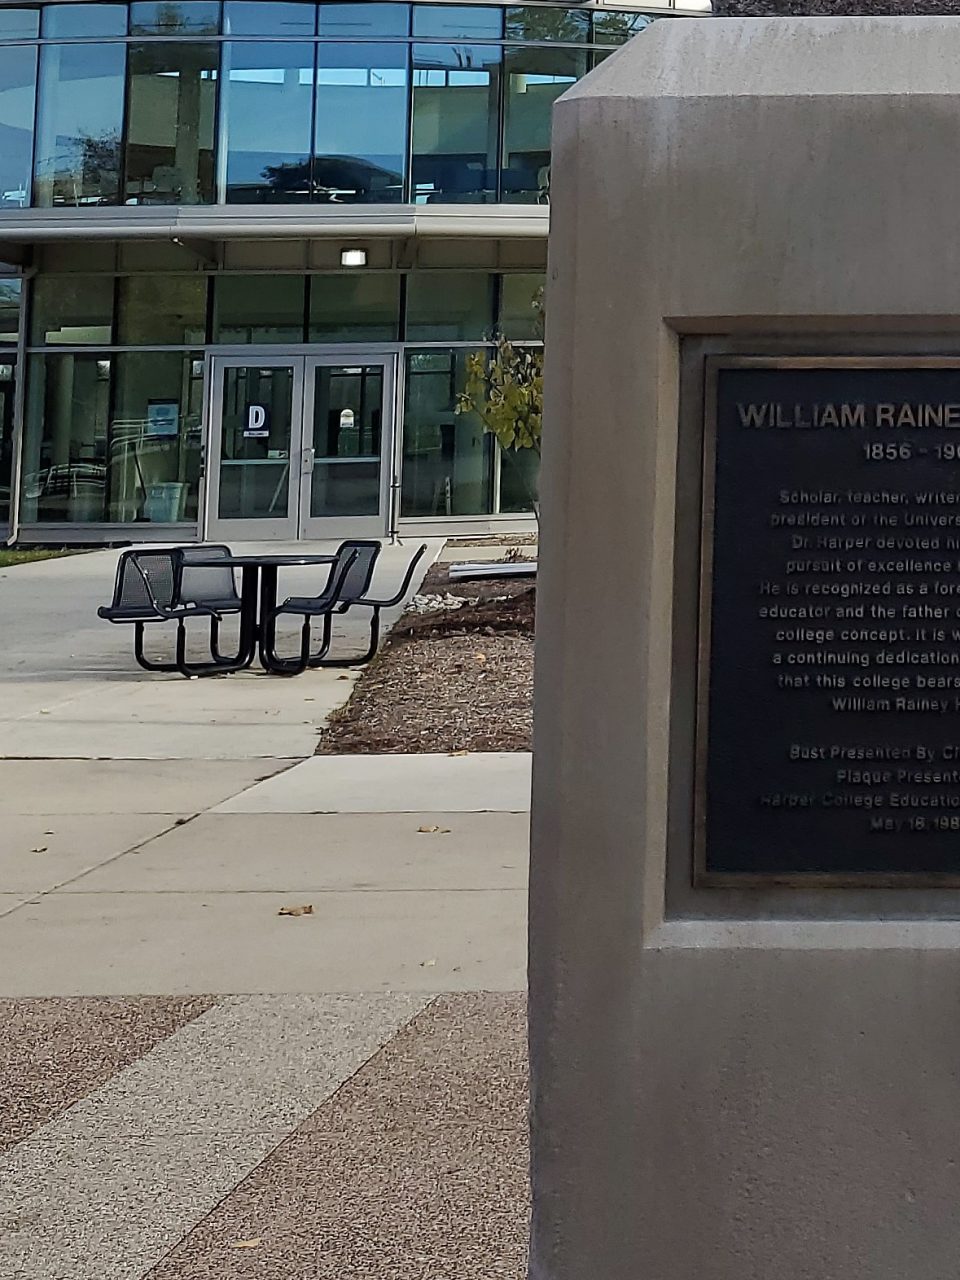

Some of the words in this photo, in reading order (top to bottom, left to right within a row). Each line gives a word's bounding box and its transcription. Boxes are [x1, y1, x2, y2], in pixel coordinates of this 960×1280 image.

[248, 405, 266, 429] D
[736, 402, 866, 429] WILLIAM
[864, 442, 911, 460] 1856
[915, 491, 960, 504] writer
[771, 513, 846, 529] president
[851, 513, 866, 527] of
[873, 513, 898, 527] the
[876, 536, 939, 549] devoted
[786, 559, 840, 575] pursuit
[847, 559, 862, 572] of
[868, 559, 951, 572] excellence
[760, 582, 780, 595] He
[787, 582, 799, 595] is
[805, 582, 891, 597] recognized
[897, 584, 914, 595] as
[920, 585, 928, 595] a
[759, 605, 831, 618] educator
[836, 605, 863, 618] and
[871, 605, 895, 618] the
[902, 605, 950, 618] father
[776, 628, 834, 643] college
[933, 628, 945, 641] is
[772, 653, 781, 664] a
[787, 651, 869, 666] continuing
[876, 651, 959, 664] dedication
[778, 675, 810, 688] that
[816, 675, 846, 688] this
[853, 675, 910, 689] college
[917, 675, 960, 688] bears
[832, 698, 890, 711] William
[896, 698, 947, 713] Rainey
[789, 745, 824, 760] Bust
[830, 745, 910, 760] Presented
[917, 745, 935, 762] By
[836, 769, 891, 786] Plaque
